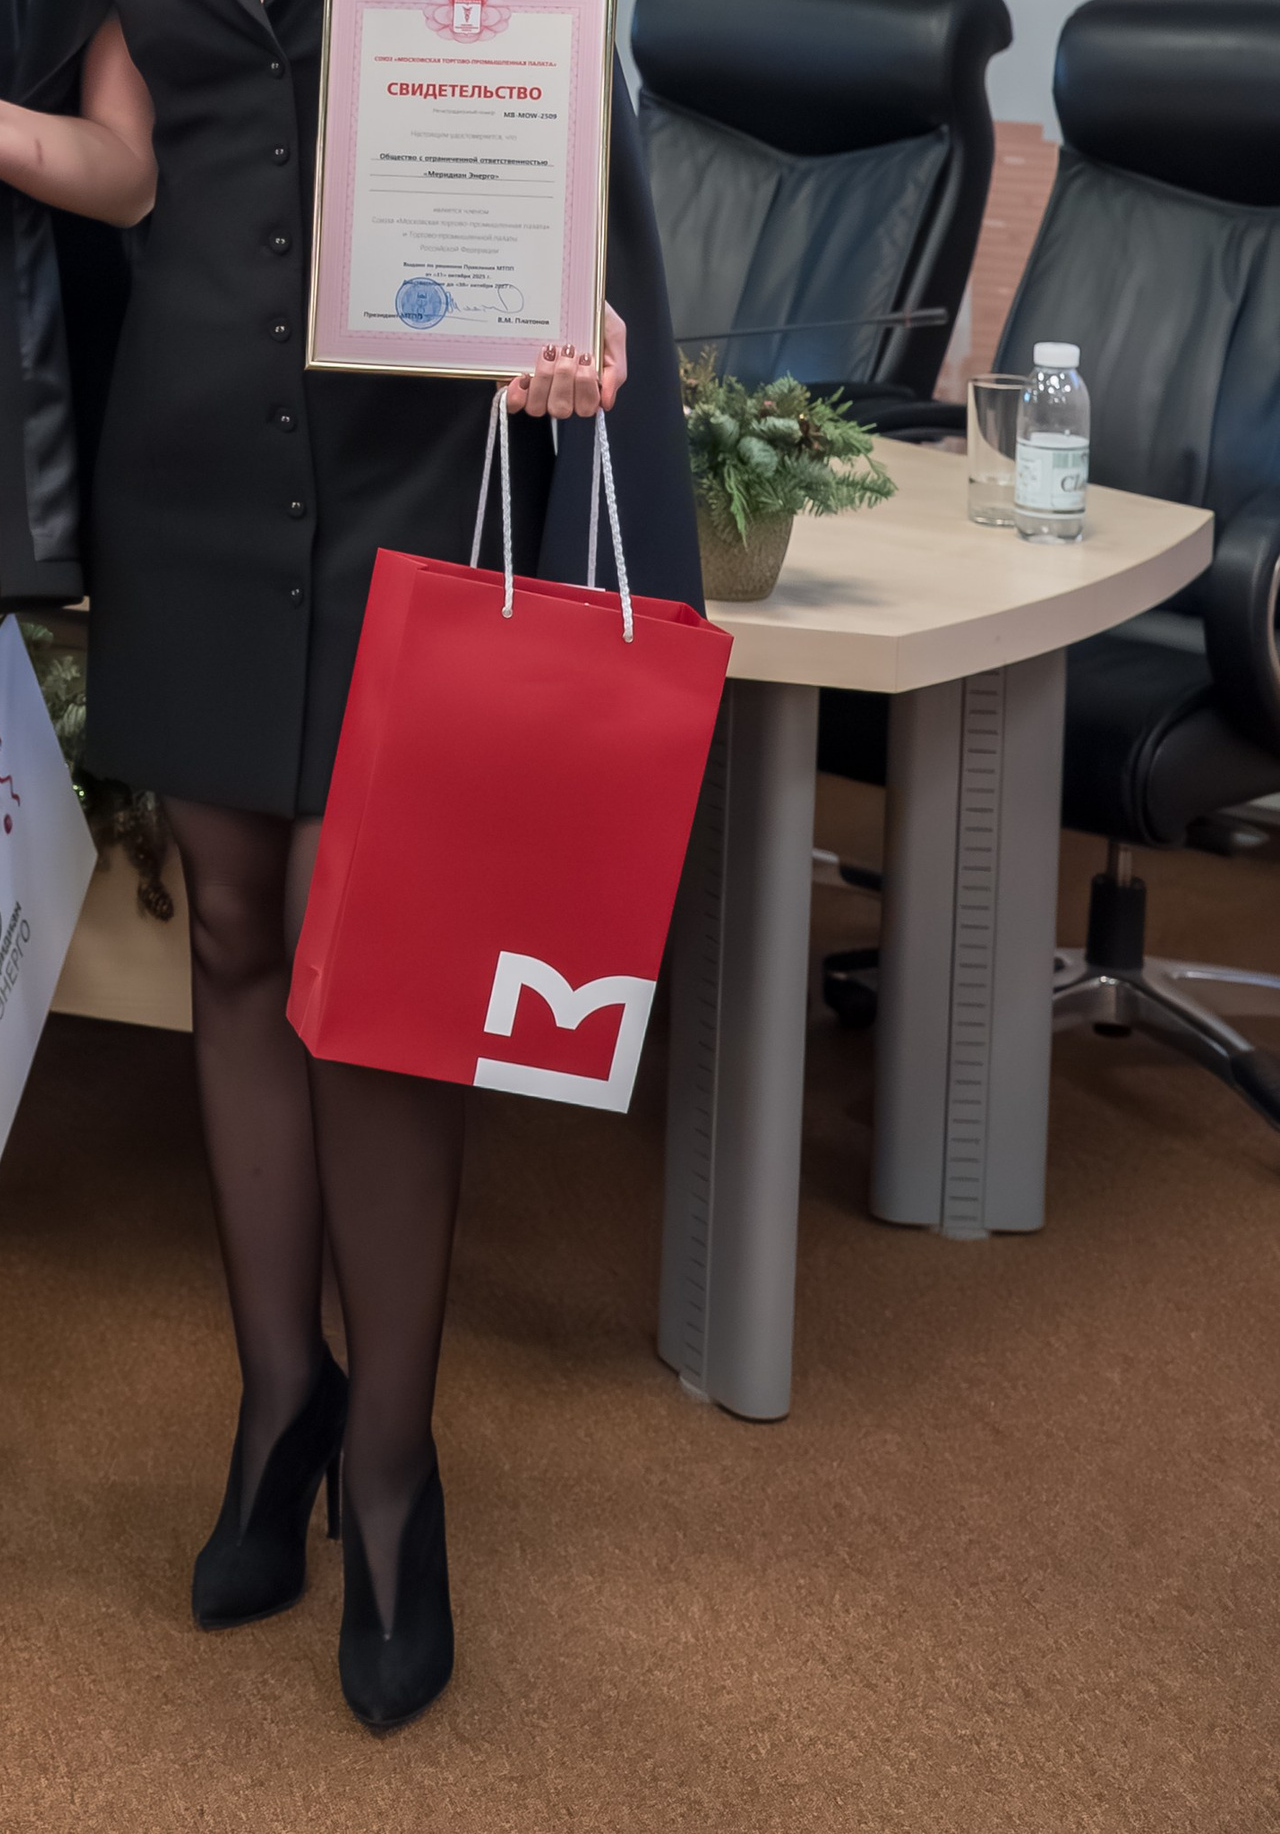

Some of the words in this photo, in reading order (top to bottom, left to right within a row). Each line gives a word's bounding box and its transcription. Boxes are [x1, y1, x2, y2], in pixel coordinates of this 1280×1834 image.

[387, 81, 542, 101] СВИДЕТЕЛЬСТВО
[379, 153, 417, 162] Общество
[424, 155, 478, 165] ограниченной
[479, 157, 548, 166] ответственностью
[423, 170, 467, 180] «Меридиан
[515, 317, 550, 325] Платонов
